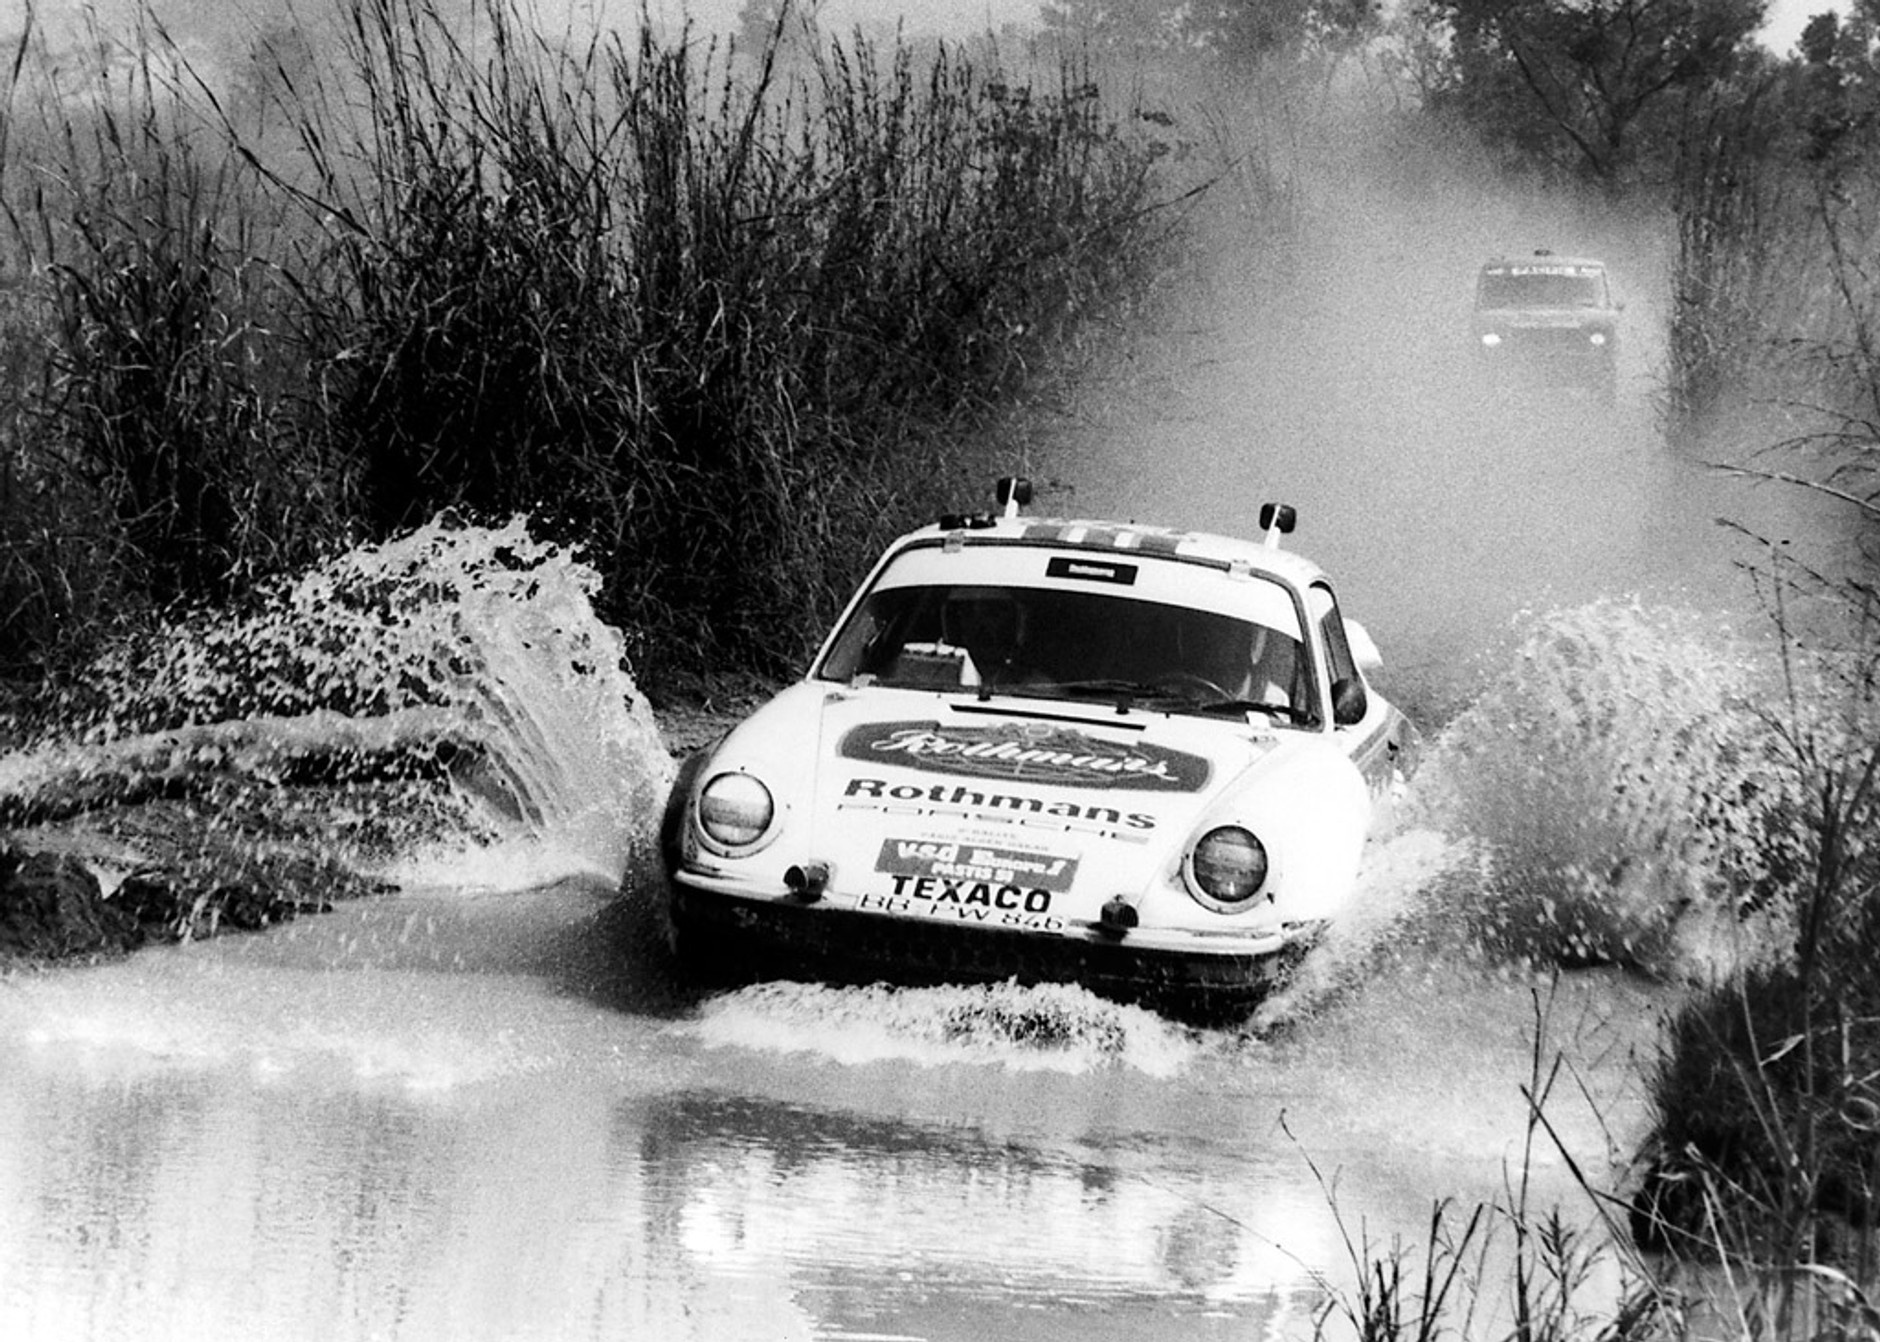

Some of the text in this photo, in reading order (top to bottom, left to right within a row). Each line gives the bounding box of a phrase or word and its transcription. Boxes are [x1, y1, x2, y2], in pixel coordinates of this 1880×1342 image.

[871, 729, 1179, 781] Rothmans
[844, 778, 1156, 830] Rothmans
[892, 874, 1052, 913] TEXACO
